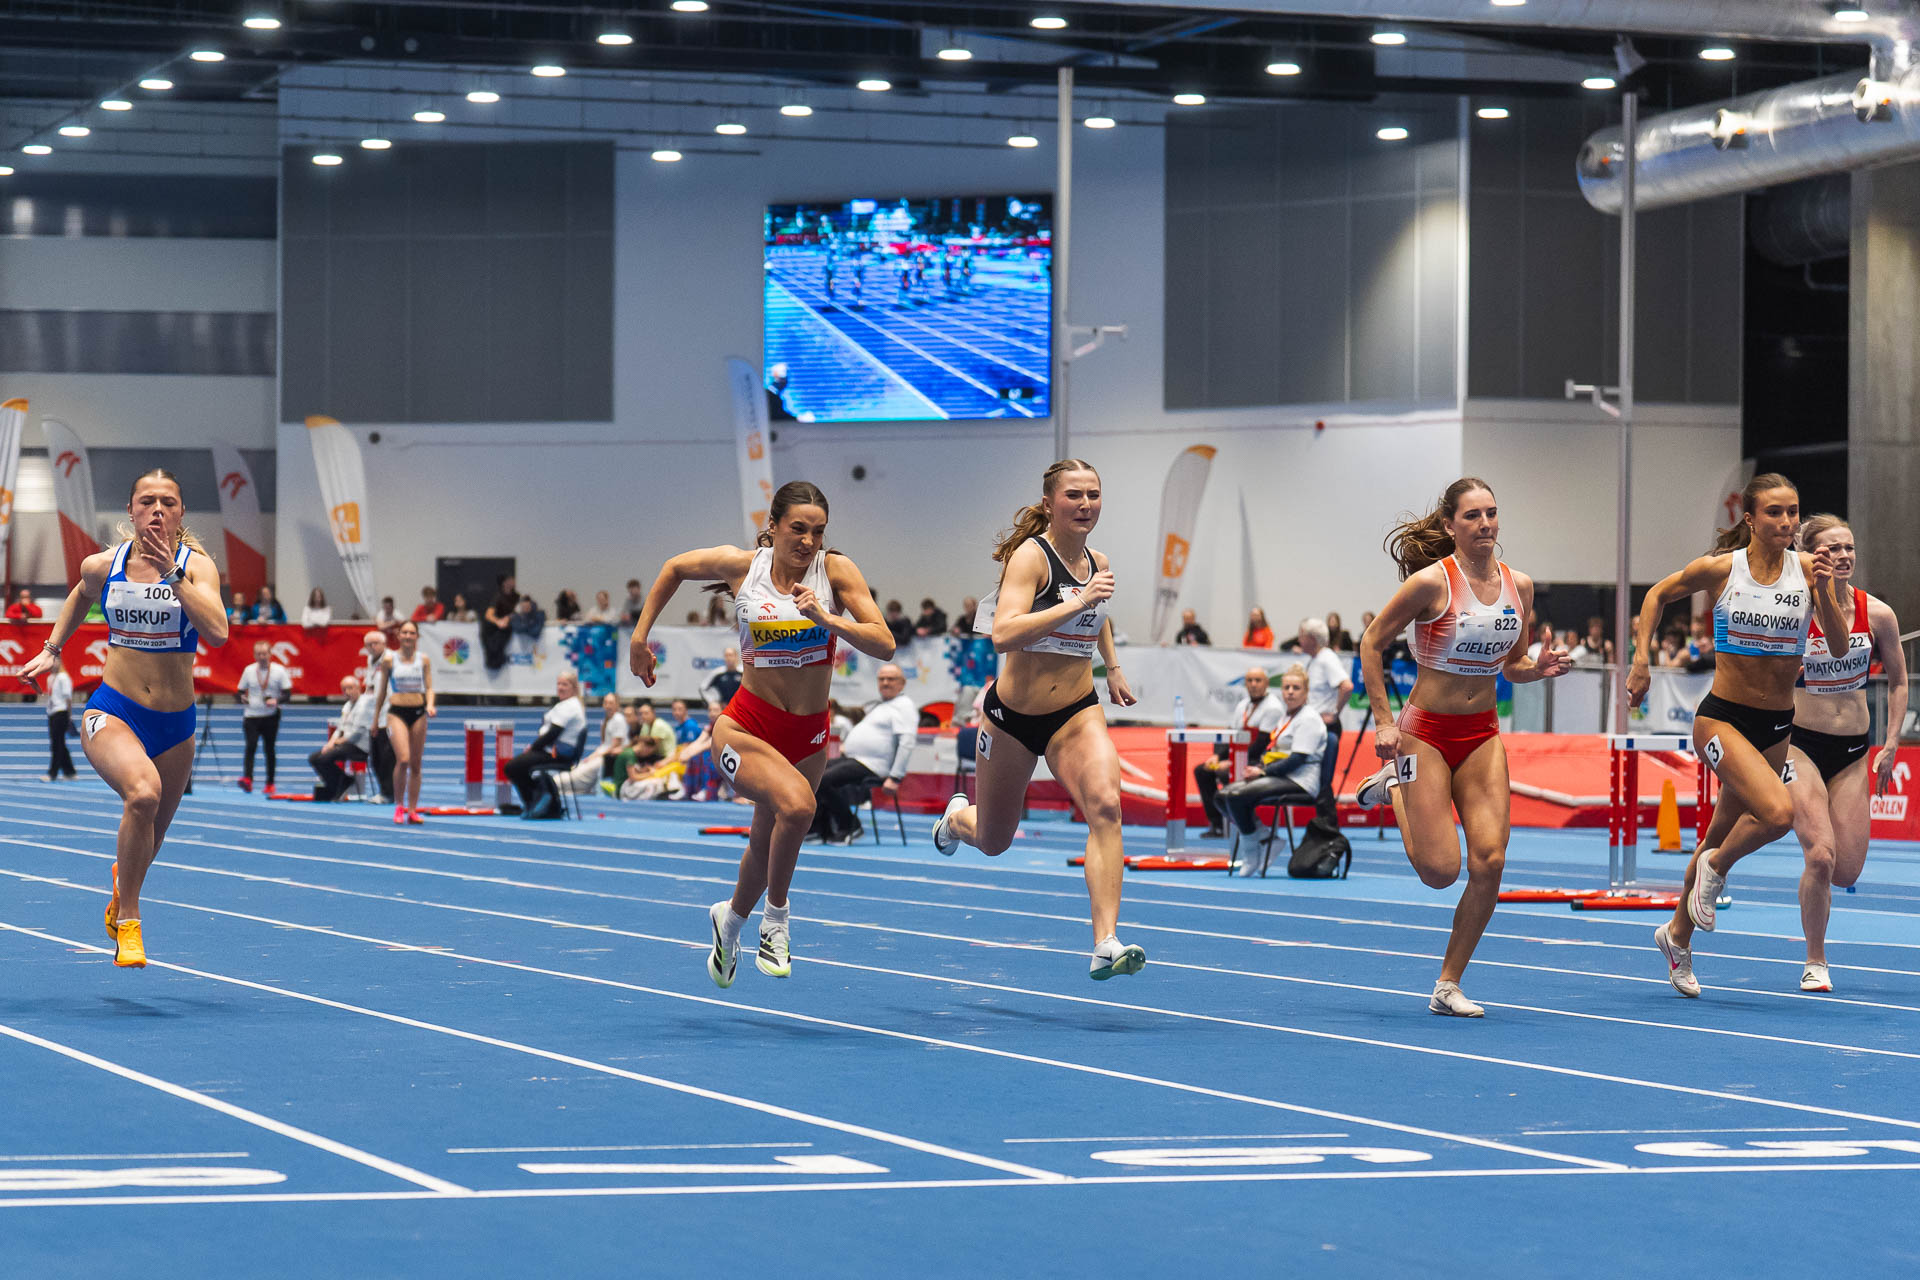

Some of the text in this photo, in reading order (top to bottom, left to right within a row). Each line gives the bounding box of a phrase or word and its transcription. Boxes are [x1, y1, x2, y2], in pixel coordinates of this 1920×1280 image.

[1774, 593, 1800, 607] 948
[115, 608, 171, 625] BISKUP
[1076, 610, 1098, 628] JEŻ
[1494, 618, 1518, 631] 822
[1732, 611, 1800, 632] GRABOWSKA
[753, 626, 827, 644] KASPRZAK
[1739, 639, 1770, 650] RZESZÓW
[1456, 640, 1514, 656] CIELECKA
[768, 656, 800, 666] RZESZÓW
[1806, 654, 1868, 676] PIĄTKOWSKA
[89, 714, 103, 733] 7
[978, 729, 988, 753] 5
[1707, 741, 1720, 763] 3
[722, 753, 737, 774] 6
[1401, 757, 1413, 780] 4
[1782, 762, 1793, 784] 2
[1872, 800, 1904, 815] ORLEN
[517, 1153, 892, 1175] 7
[1091, 1146, 1434, 1167] 6
